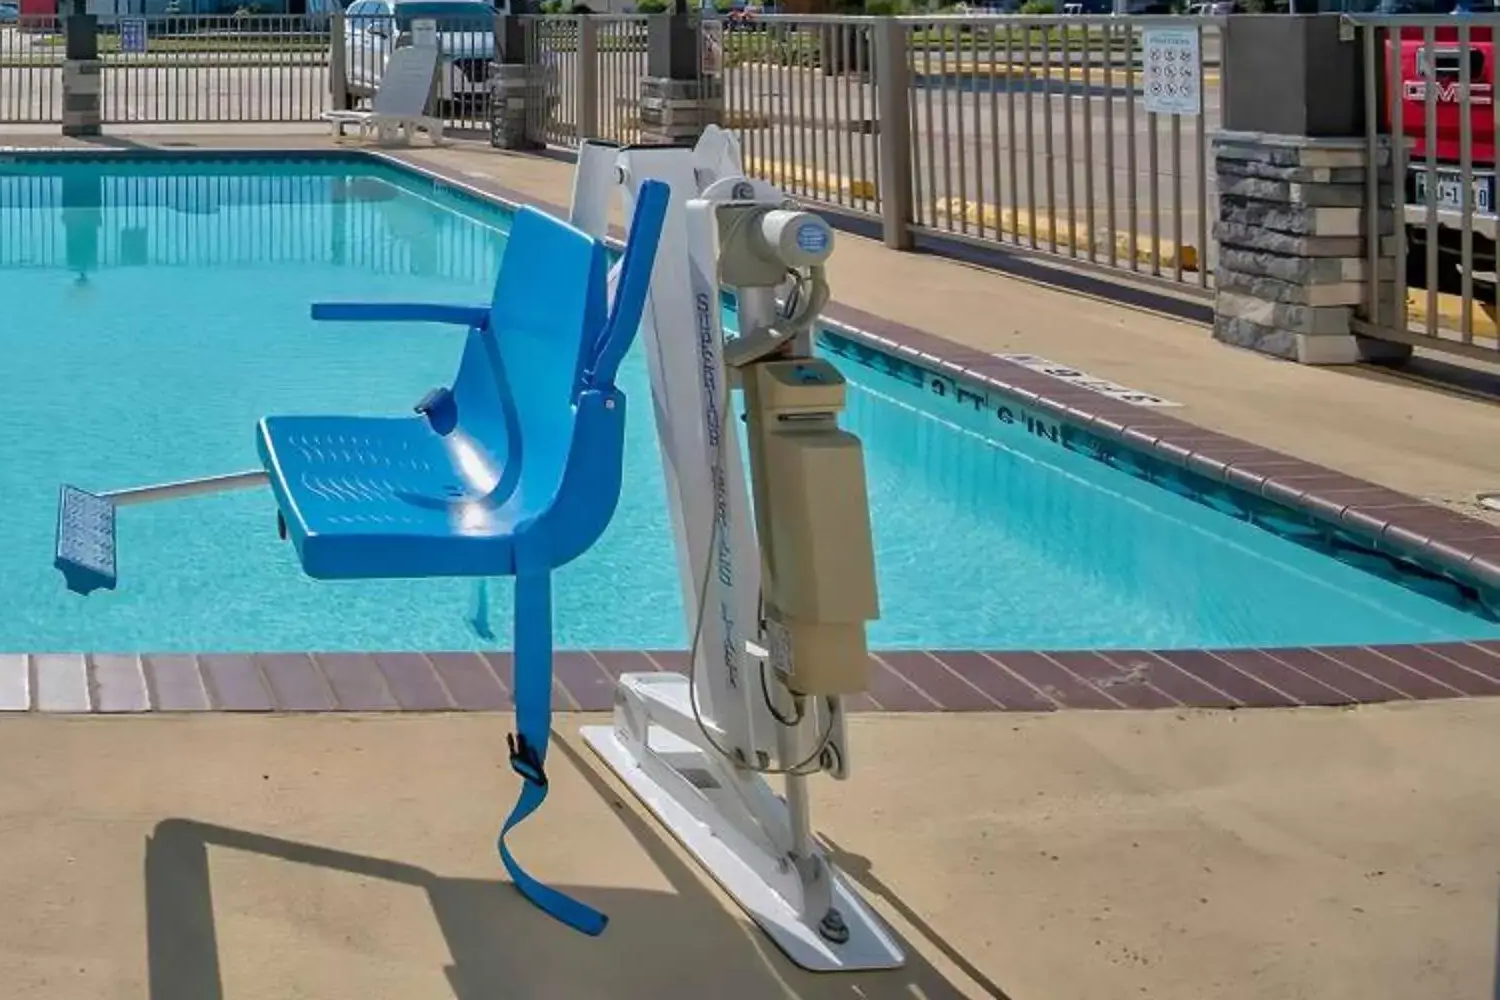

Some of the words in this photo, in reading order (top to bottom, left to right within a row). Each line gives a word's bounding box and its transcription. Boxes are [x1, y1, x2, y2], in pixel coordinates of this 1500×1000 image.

[1403, 80, 1493, 105] GMC
[957, 387, 985, 411] FT
[996, 404, 1015, 425] 6
[1025, 416, 1060, 444] IN
